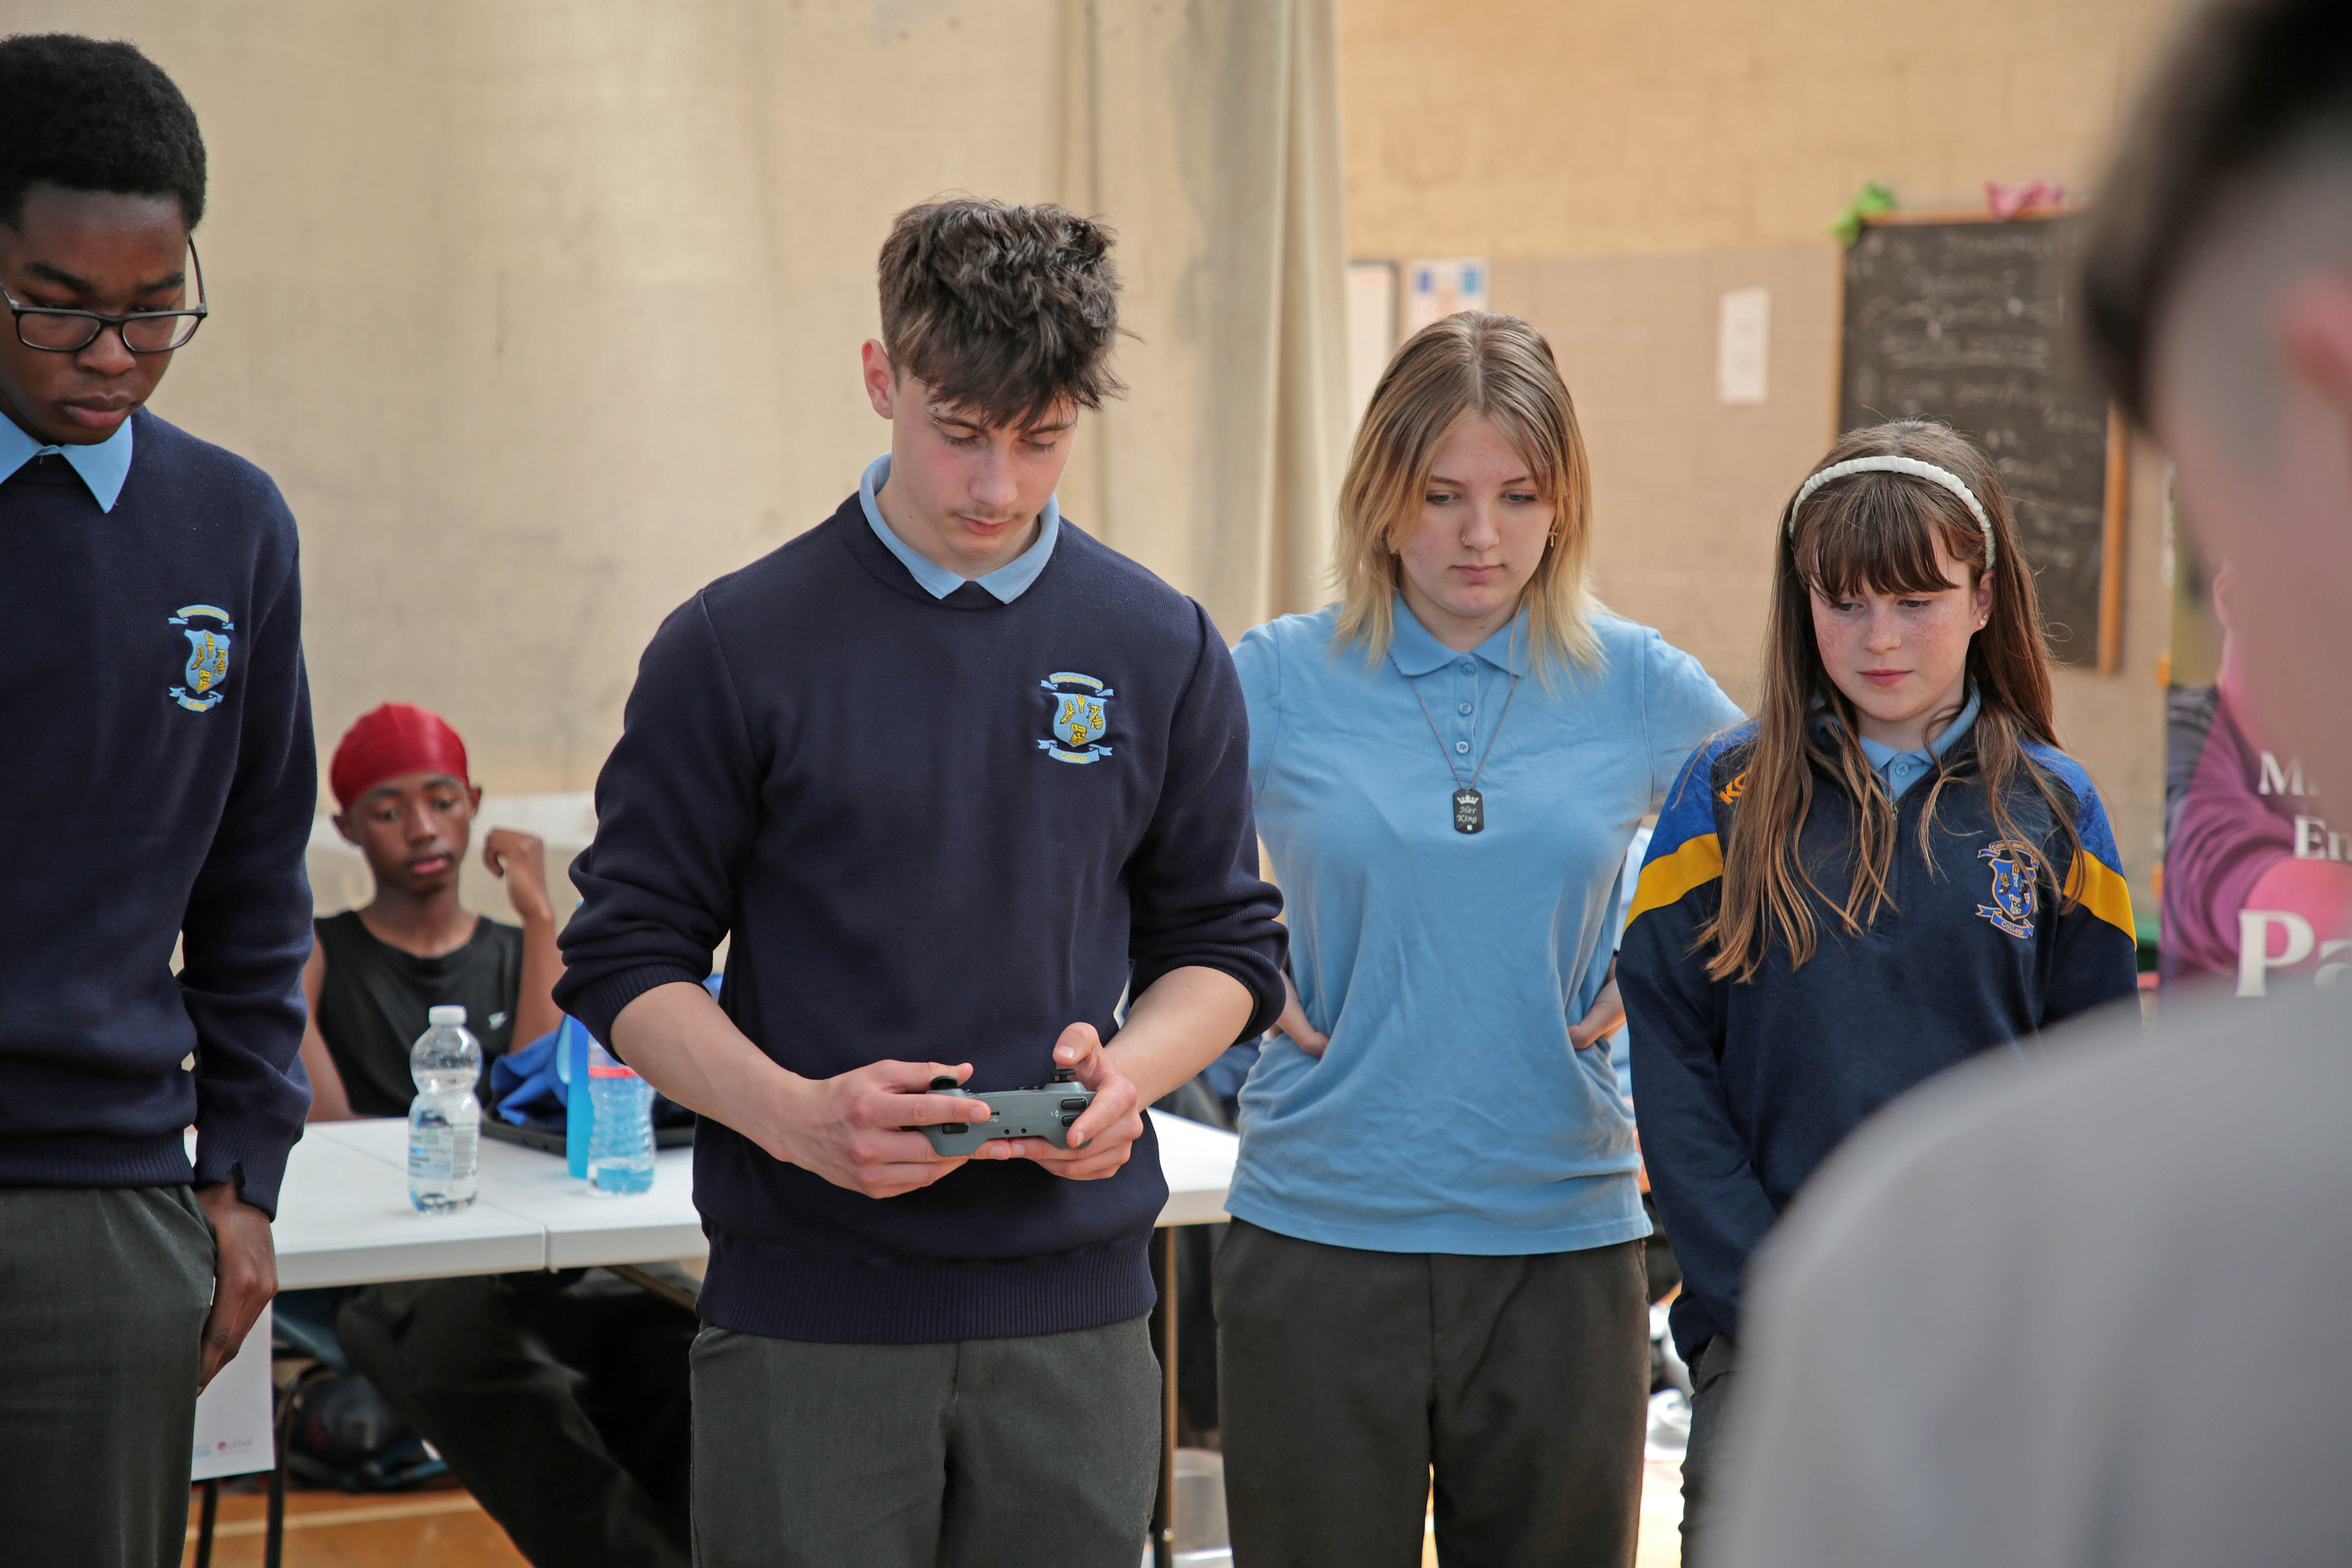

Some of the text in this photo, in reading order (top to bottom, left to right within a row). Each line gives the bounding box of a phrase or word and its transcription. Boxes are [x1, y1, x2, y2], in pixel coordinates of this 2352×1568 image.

[1060, 751, 1087, 764] College
[1459, 806, 1477, 814] Her
[1456, 815, 1477, 824] King
